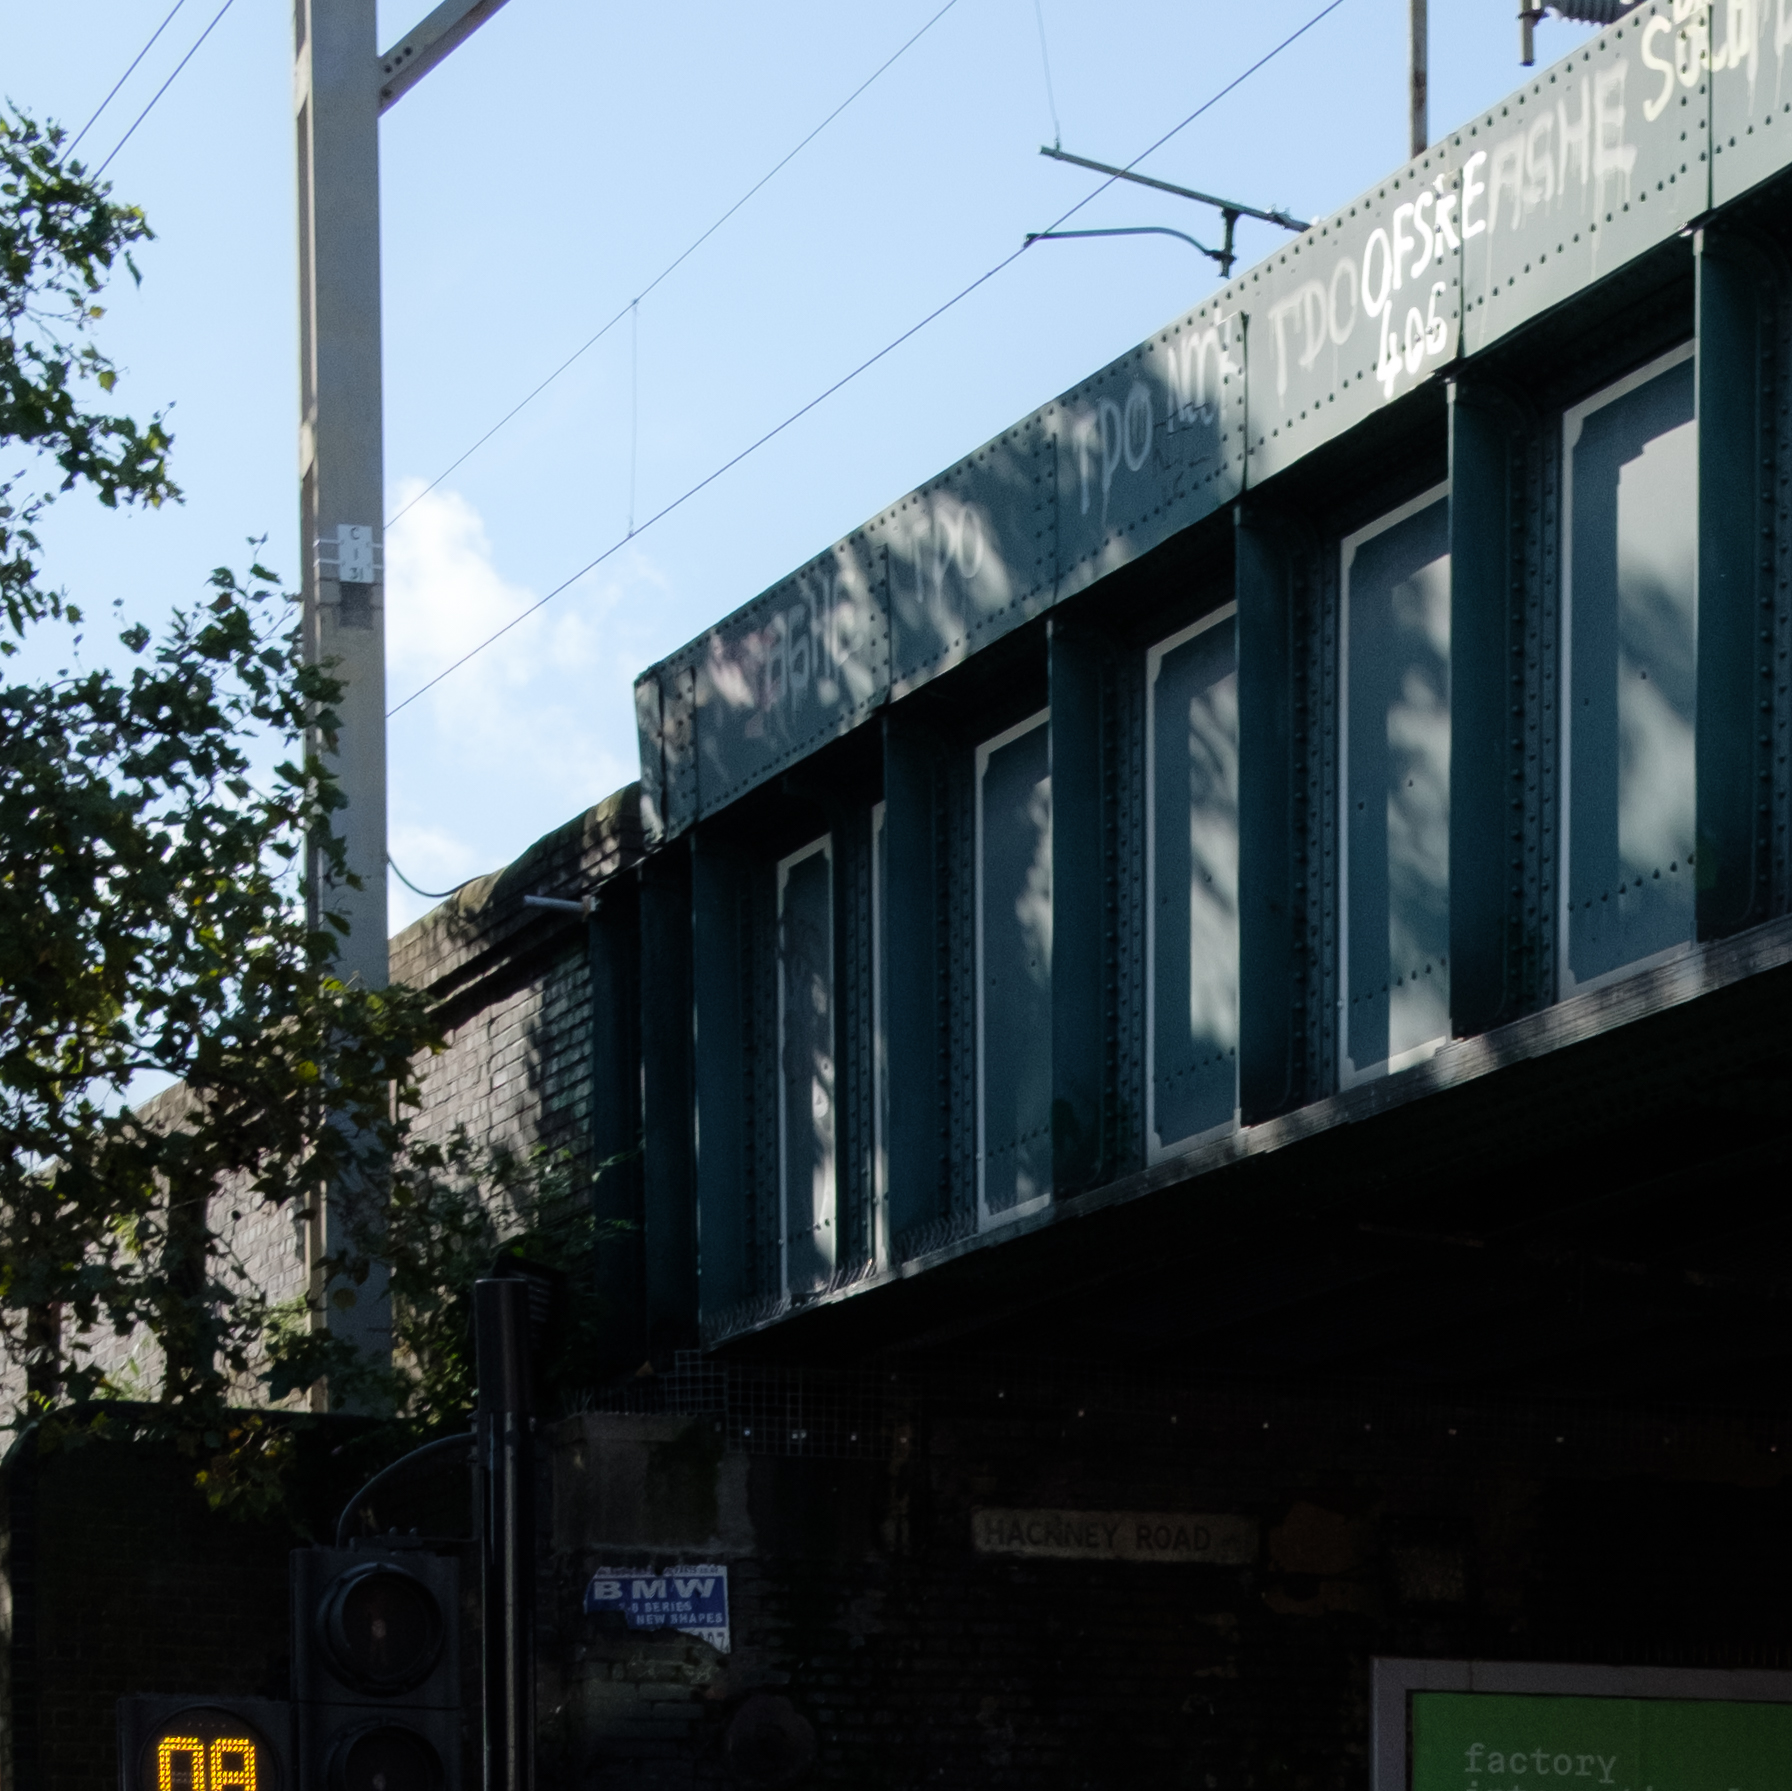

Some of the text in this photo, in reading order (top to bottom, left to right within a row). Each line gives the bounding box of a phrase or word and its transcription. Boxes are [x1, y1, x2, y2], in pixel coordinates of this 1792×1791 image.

[983, 1517, 1120, 1550] HACKNEY
[1136, 1524, 1212, 1552] ROAD
[593, 1578, 716, 1601] BMW
[643, 1601, 693, 1613] SERIES
[636, 1612, 724, 1626] NEW SHAPES
[1464, 1742, 1617, 1784] factory
